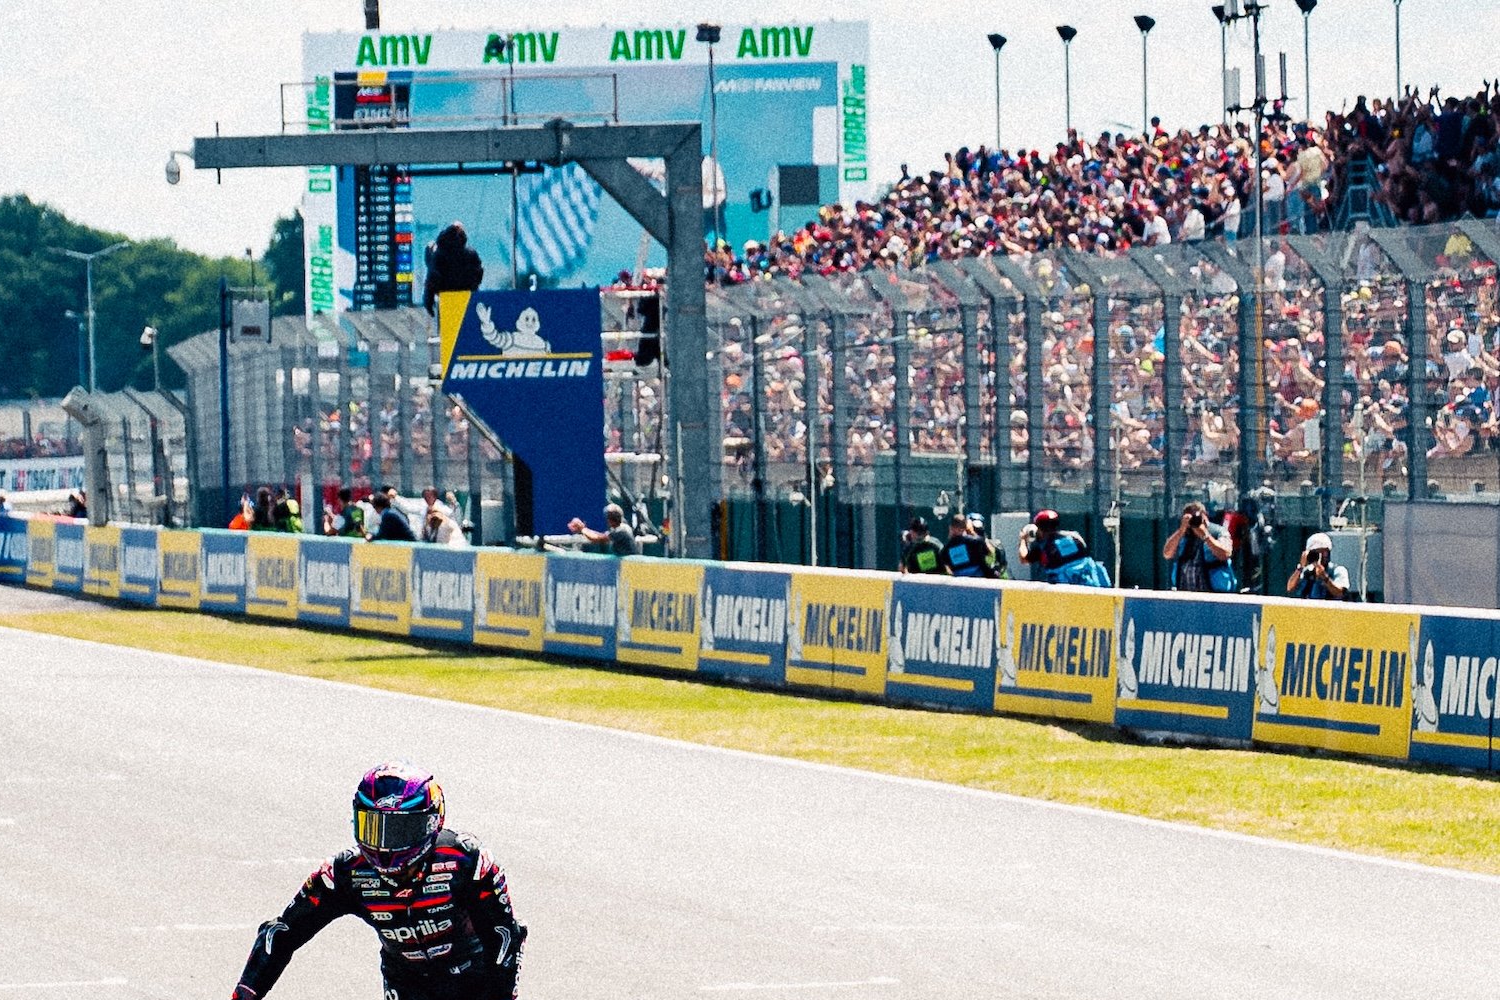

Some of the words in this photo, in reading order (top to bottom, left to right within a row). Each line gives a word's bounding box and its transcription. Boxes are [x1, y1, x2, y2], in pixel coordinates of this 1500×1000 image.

[451, 360, 590, 380] MICHELIN
[555, 581, 616, 626] MICHELIN
[632, 589, 695, 634] MICHELIN
[713, 593, 786, 645] MICHELIN
[804, 603, 884, 654] MICHELIN
[905, 612, 995, 669] MICHELIN
[1019, 622, 1112, 678] MICHELIN
[1139, 631, 1252, 694] MICHELIN
[1281, 641, 1407, 708] MICHELIN
[380, 919, 453, 943] aprilia
